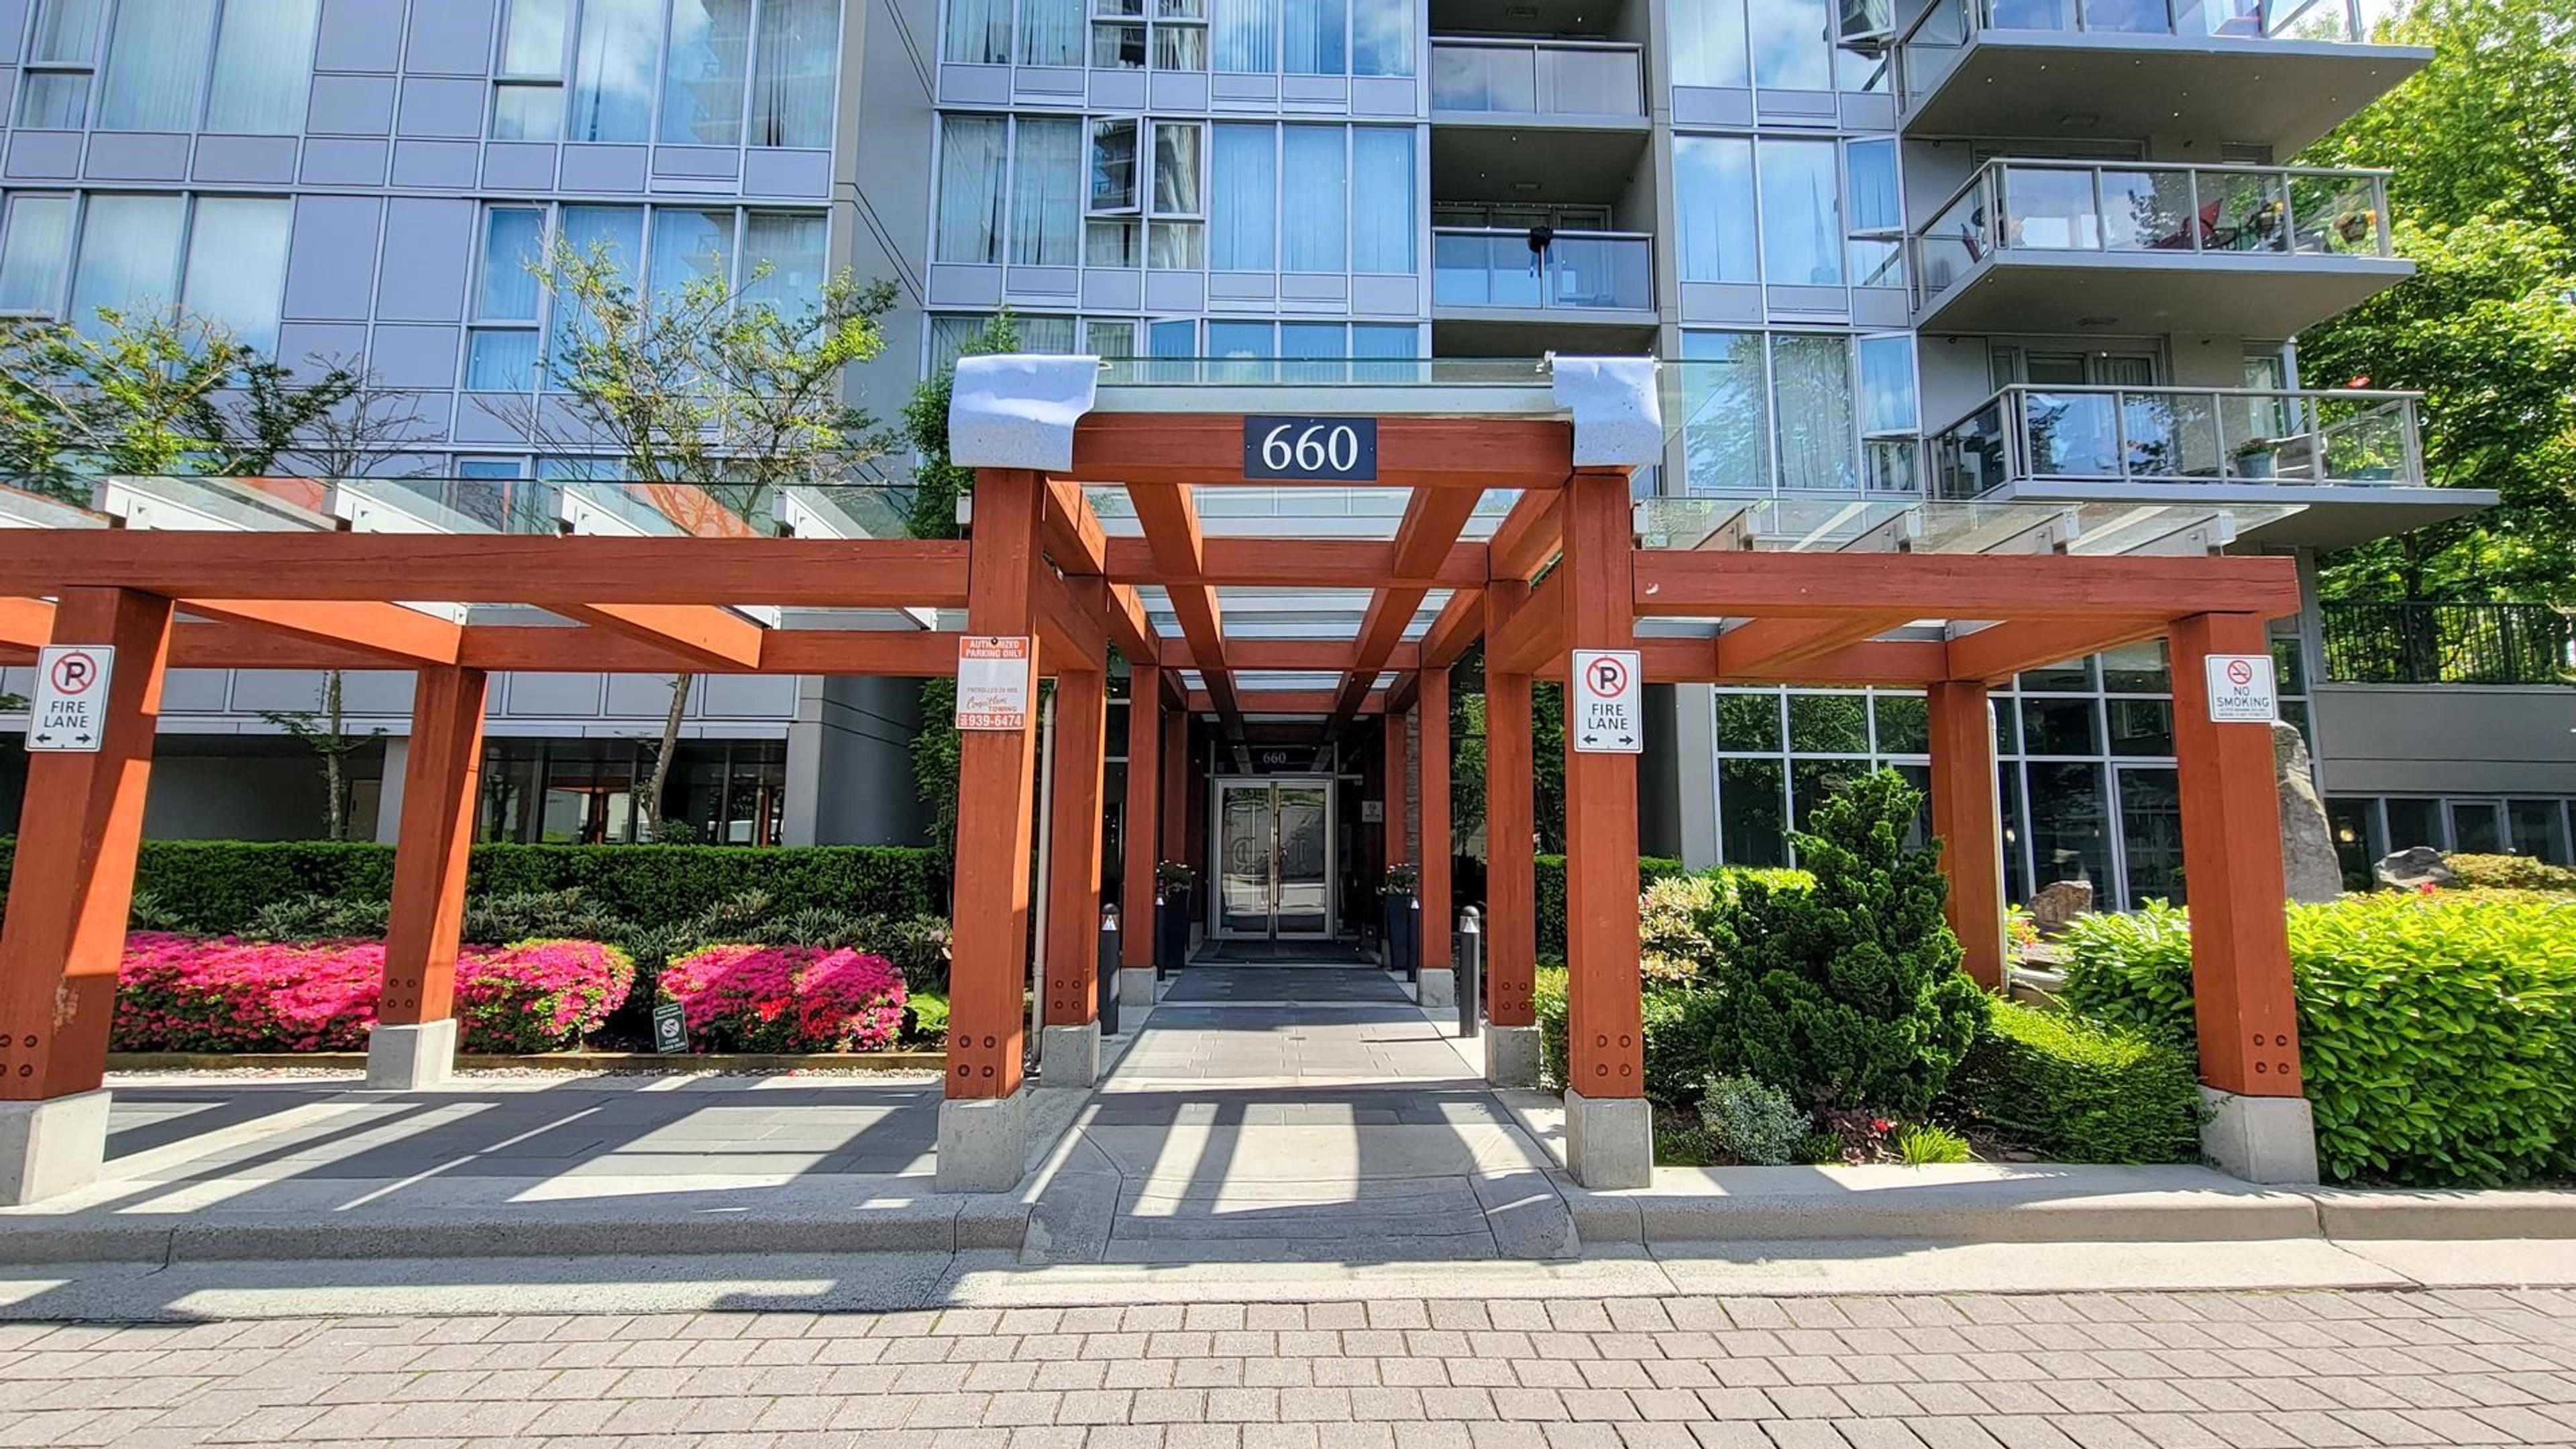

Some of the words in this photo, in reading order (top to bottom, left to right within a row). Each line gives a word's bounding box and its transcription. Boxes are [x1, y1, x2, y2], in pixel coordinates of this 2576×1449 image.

[1263, 424, 1358, 471] 660
[966, 649, 1001, 657] PARKING
[1002, 649, 1023, 657] ONLY
[64, 661, 86, 686] P
[1600, 666, 1618, 690] P
[2233, 686, 2250, 696] NO
[50, 701, 87, 714] FIRE
[2216, 696, 2270, 708] SMOKING
[1592, 703, 1624, 716] FIRE
[44, 715, 89, 729] LANE
[968, 714, 1021, 727] 939-6474
[1588, 718, 1629, 731] LANE
[1263, 751, 1287, 763] 660
